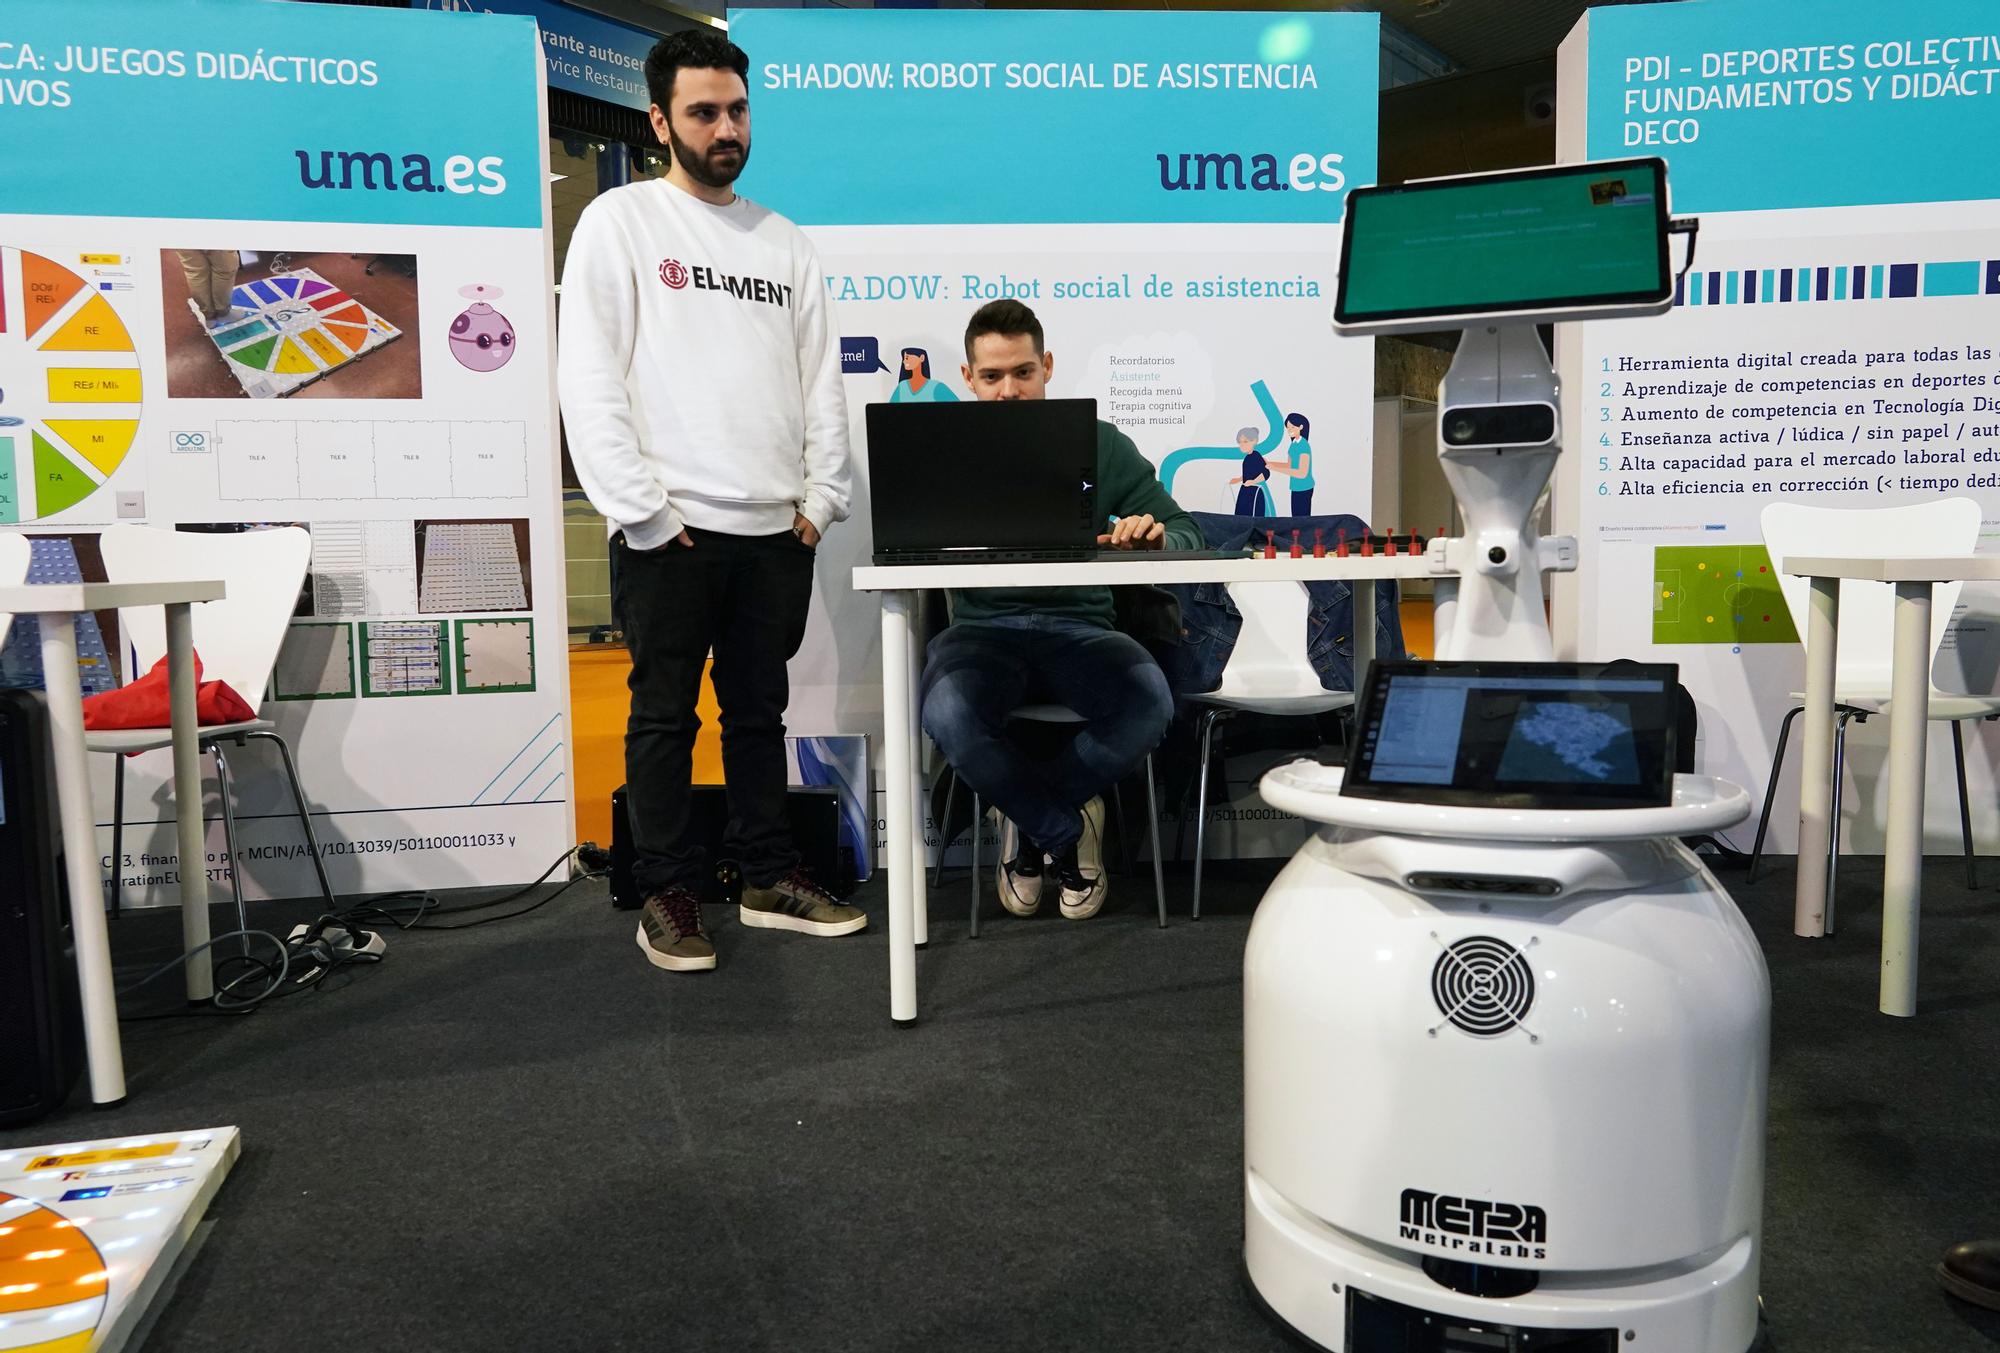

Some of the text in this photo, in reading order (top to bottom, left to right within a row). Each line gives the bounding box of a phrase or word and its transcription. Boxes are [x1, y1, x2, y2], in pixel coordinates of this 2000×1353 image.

[54, 46, 186, 77] JUEGOS
[197, 50, 378, 86] DIDÁCTICOS
[589, 45, 646, 72] autoser
[1626, 57, 1670, 82] PDI
[1702, 44, 1854, 78] DEPORTES
[764, 62, 1318, 89] SHADOW: ROBOT SOCIAL DE ASISTENCIA
[1625, 64, 2000, 114] FUNDAMENTOS Y DIDÁCT
[1624, 118, 1700, 146] DECO
[295, 150, 506, 195] uma.es
[1156, 152, 1346, 192] uma.es
[962, 274, 1040, 300] Robot
[1054, 274, 1130, 299] social
[1144, 274, 1173, 298] de
[1186, 275, 1320, 298] asistencia
[84, 326, 100, 334] RE
[1110, 356, 1176, 366] Recordatorios
[1602, 346, 1991, 372] 1. Herramienta digital creada para todas las
[1111, 370, 1160, 382] Asistente
[1600, 382, 1614, 397] 2.
[1622, 380, 1727, 399] Aprendizaje
[1734, 378, 1754, 393] de
[1761, 376, 1876, 394] competencias
[1884, 377, 1904, 388] en
[1912, 372, 1986, 390] deportes
[1110, 386, 1182, 398] Recogida menú
[1109, 401, 1192, 412] Terapia cognitiva
[1600, 408, 1612, 422] 3.
[1621, 406, 1698, 422] Aumento
[1706, 404, 1724, 418] de
[1732, 402, 1837, 420] competencia
[1845, 404, 1865, 415] en
[1873, 398, 1964, 416] Tecnología
[1109, 415, 1186, 426] Terapia musical
[92, 435, 104, 443] MI
[1600, 422, 2000, 446] 4. Enseñanza activa / lúdica / sin papel / aut
[1598, 448, 2000, 472] 5. Alta capacidad para el mercado laboral edu
[49, 473, 64, 481] FA
[1598, 482, 1612, 496] 6.
[1619, 480, 1655, 496] Alta
[1662, 480, 1744, 494] eficiencia
[1752, 482, 1772, 493] en
[1780, 477, 1868, 492] corrección
[1900, 475, 1959, 492] tiempo
[248, 834, 504, 860] MCIN/AE/10.13039/501100011033
[509, 836, 516, 848] y
[1400, 1188, 1546, 1243] METRA
